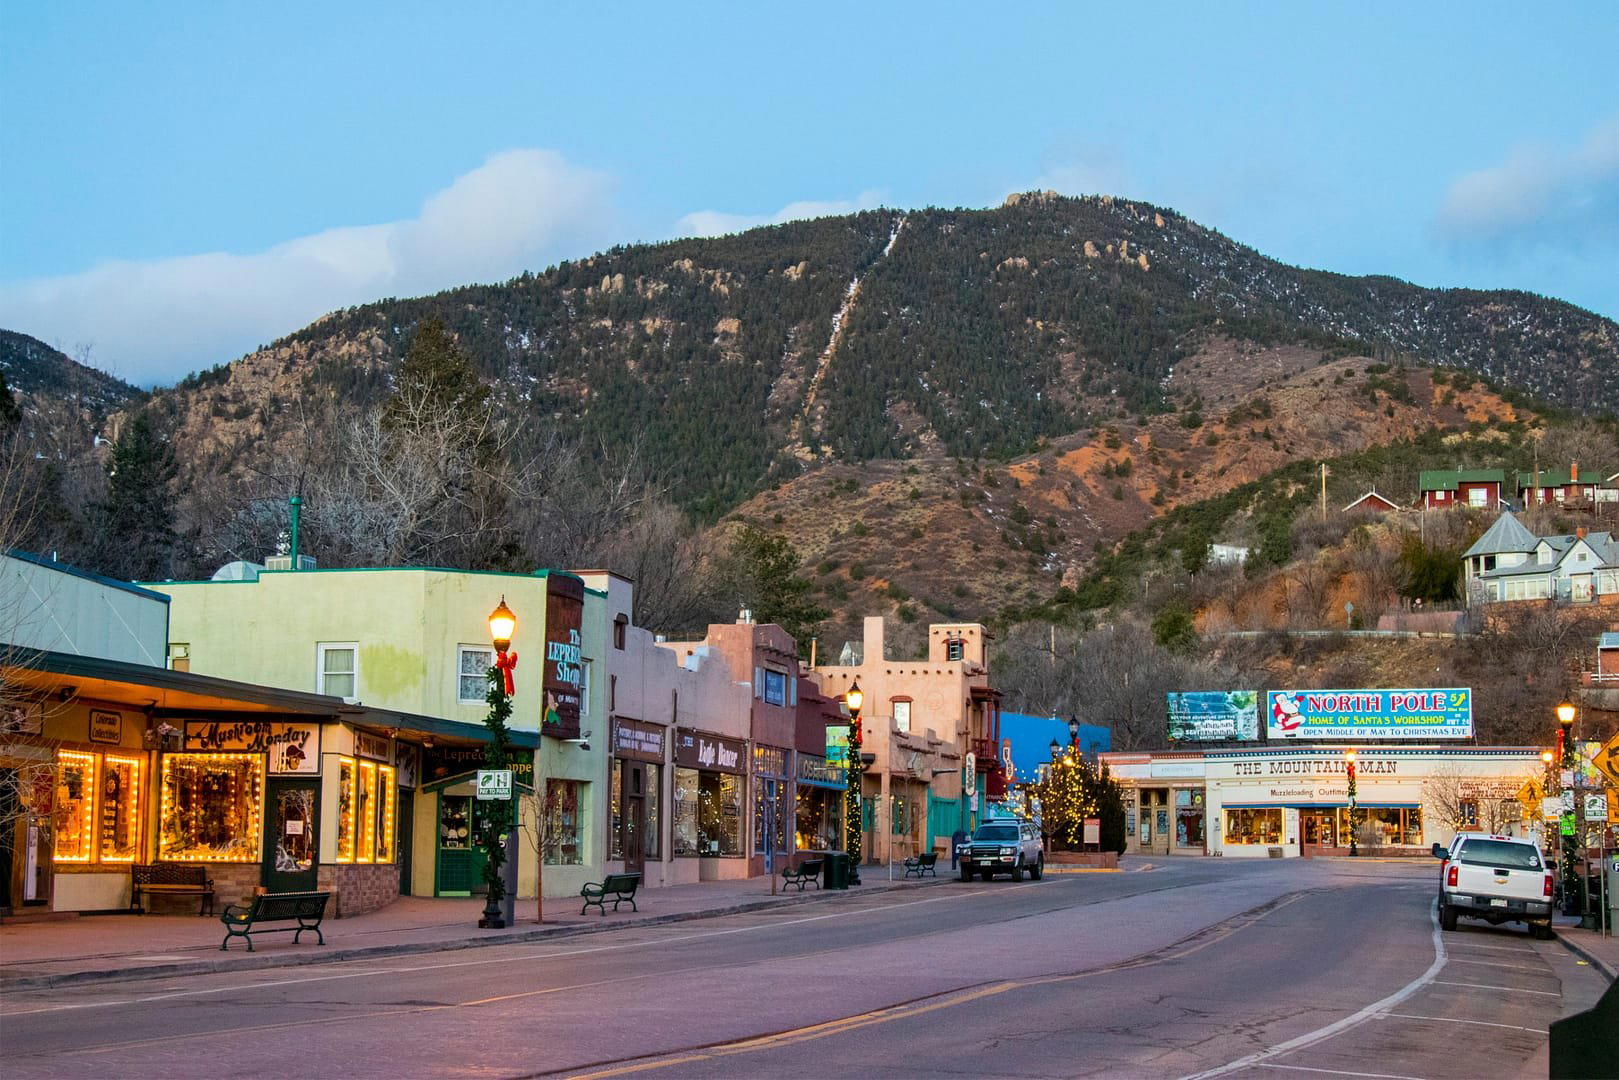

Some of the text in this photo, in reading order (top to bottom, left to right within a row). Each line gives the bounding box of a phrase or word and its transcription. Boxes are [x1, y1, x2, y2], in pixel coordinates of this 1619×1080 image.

[1307, 693, 1457, 712] NORTH POLE 5
[1308, 716, 1334, 725] HOME
[1338, 716, 1350, 725] OF
[1393, 715, 1445, 725] WORKSHOP
[200, 720, 271, 749] Mushroom
[1303, 727, 1468, 736] OPEN MIDDLE OF MAY TO CHRISTMAS EVE
[246, 727, 310, 751] Monday
[1233, 761, 1397, 775] THE MOUNTAIN MAN
[1270, 788, 1350, 798] Muzzleloading Outfitter
